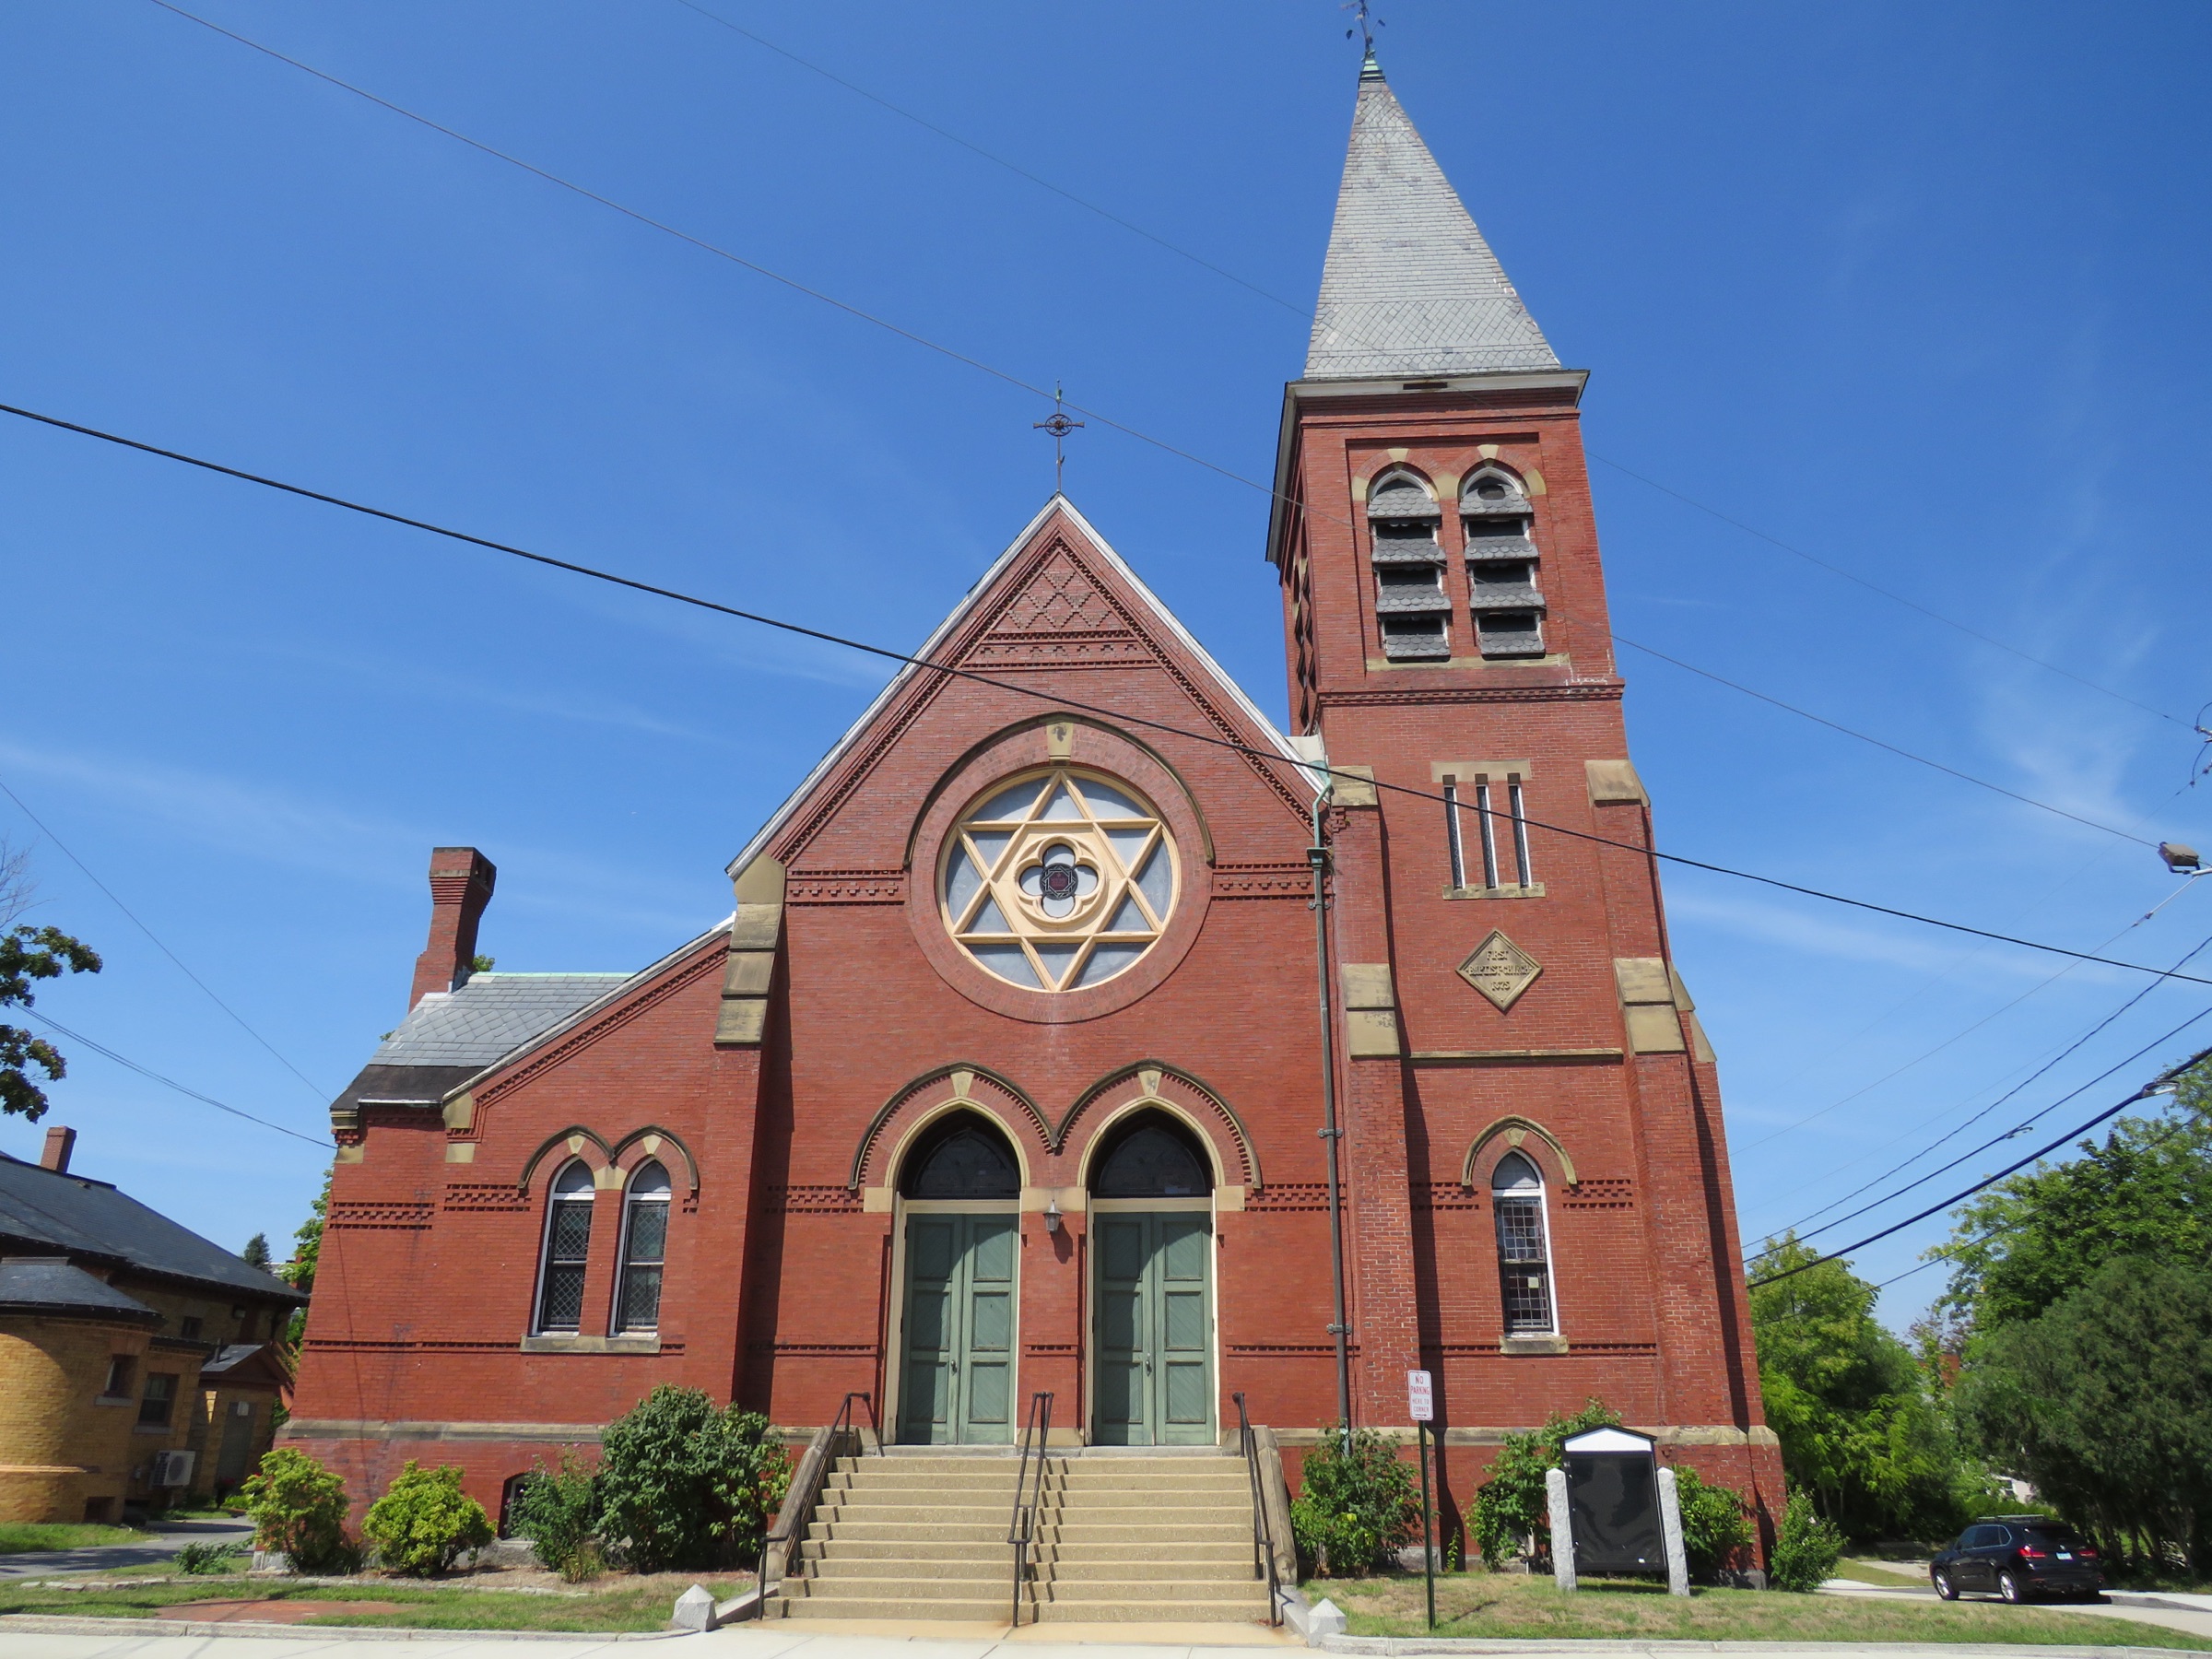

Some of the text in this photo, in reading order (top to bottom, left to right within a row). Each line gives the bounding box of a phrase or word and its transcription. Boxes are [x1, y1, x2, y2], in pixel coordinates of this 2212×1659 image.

[1486, 950, 1509, 960] FIRST
[1469, 965, 1530, 976] BAPTIST CHURCH
[1415, 1375, 1424, 1384] NO
[1410, 1385, 1430, 1395] PARKING
